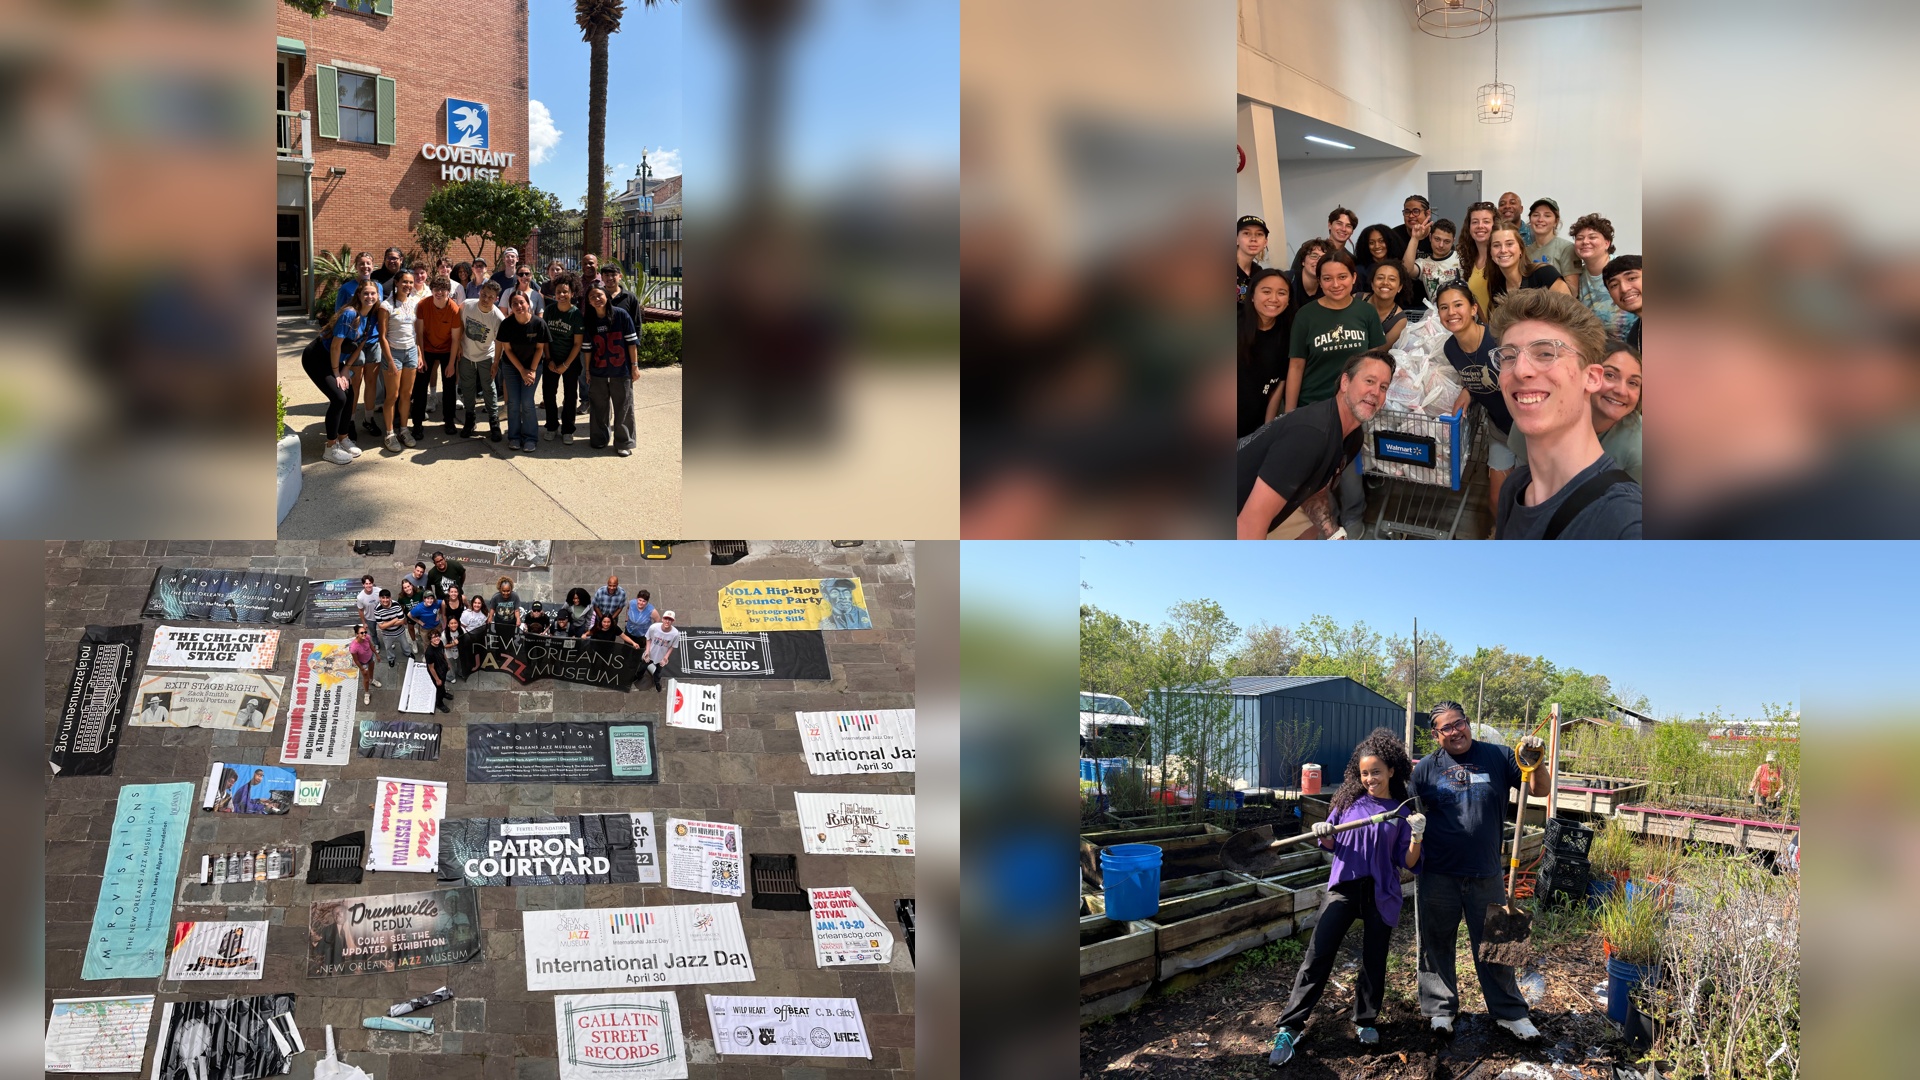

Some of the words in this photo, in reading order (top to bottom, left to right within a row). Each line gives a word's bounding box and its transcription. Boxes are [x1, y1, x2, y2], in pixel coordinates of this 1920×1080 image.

[422, 143, 515, 167] COVENANT
[441, 164, 500, 182] HOUSE
[1314, 333, 1333, 348] CAL
[1344, 329, 1366, 341] POLY
[594, 332, 626, 368] 25
[1322, 342, 1362, 352] MUSTANGS
[1386, 444, 1413, 453] Walmart
[160, 575, 301, 594] IMPROVISATIONS
[725, 587, 762, 596] NOLA
[766, 587, 819, 596] Hip-Hop
[736, 597, 783, 605] Bounce
[786, 597, 823, 605] Party
[169, 633, 200, 641] THE
[203, 634, 267, 643] CHI-CHI
[694, 640, 755, 650] GALLATIN
[176, 642, 253, 652] MILLMAN
[472, 635, 523, 656] NEW
[528, 646, 624, 670] ORLEANS
[188, 652, 237, 661] STAGE
[705, 651, 746, 660] STREET
[472, 652, 526, 682] JAZZ
[531, 664, 619, 686] MUSEUM
[694, 660, 760, 671] RECORDS
[164, 682, 189, 690] EXIT
[191, 683, 225, 691] STAGE
[226, 684, 259, 692] RIGHT
[55, 645, 91, 752] nolajazzmuseum.org
[296, 687, 308, 706] and
[316, 734, 325, 746] The
[321, 690, 331, 710] Eagles
[304, 749, 313, 759] Big
[309, 714, 318, 731] Monk
[327, 726, 338, 758] Photographs
[364, 731, 411, 740] CULINARY
[414, 733, 438, 741] ROW
[479, 728, 604, 741] IMPROVISATIONS
[812, 747, 885, 762] national
[857, 763, 879, 771] April
[300, 787, 321, 797] OW
[148, 806, 156, 824] GALA
[143, 827, 153, 857] MUSEUM
[158, 821, 168, 851] Foundation
[489, 838, 585, 857] PATRON
[156, 853, 164, 870] Alpert
[465, 857, 611, 877] COURTYARD
[636, 855, 650, 864] 22
[139, 859, 148, 876] JAZZ
[100, 792, 142, 970] IMPROVISATIONS
[133, 878, 144, 913] ORLEANS
[813, 890, 851, 899] ORLEANS
[146, 907, 155, 931] Presented
[348, 899, 439, 927] Drumsville
[815, 910, 847, 919] STIVAL
[129, 916, 137, 933] NEW
[373, 918, 412, 932] REDUX
[817, 922, 838, 930] JAN.
[840, 921, 865, 929] 19-20
[358, 937, 385, 946] COME
[391, 934, 407, 943] SEE
[412, 931, 430, 939] THE
[568, 931, 589, 940] JAZZ
[818, 931, 883, 939] orleanscbg.com
[126, 937, 135, 951] THE
[342, 945, 387, 957] UPDATED
[392, 938, 446, 952] EXHIBITION
[320, 964, 345, 974] NEW
[349, 960, 394, 972] ORLEANS
[398, 956, 422, 967] JAZZ
[426, 950, 468, 962] MUSEUM
[536, 954, 658, 974] International
[664, 953, 708, 969] Jazz
[714, 951, 748, 968] Day
[626, 974, 650, 984] April
[653, 973, 666, 982] 30
[733, 1006, 750, 1014] WILD
[816, 1009, 825, 1017] C.
[827, 1009, 835, 1017] B.
[837, 1009, 855, 1019] Gitty
[578, 1013, 659, 1029] GALLATIN
[592, 1030, 648, 1043] STREET
[585, 1044, 659, 1060] RECORDS
